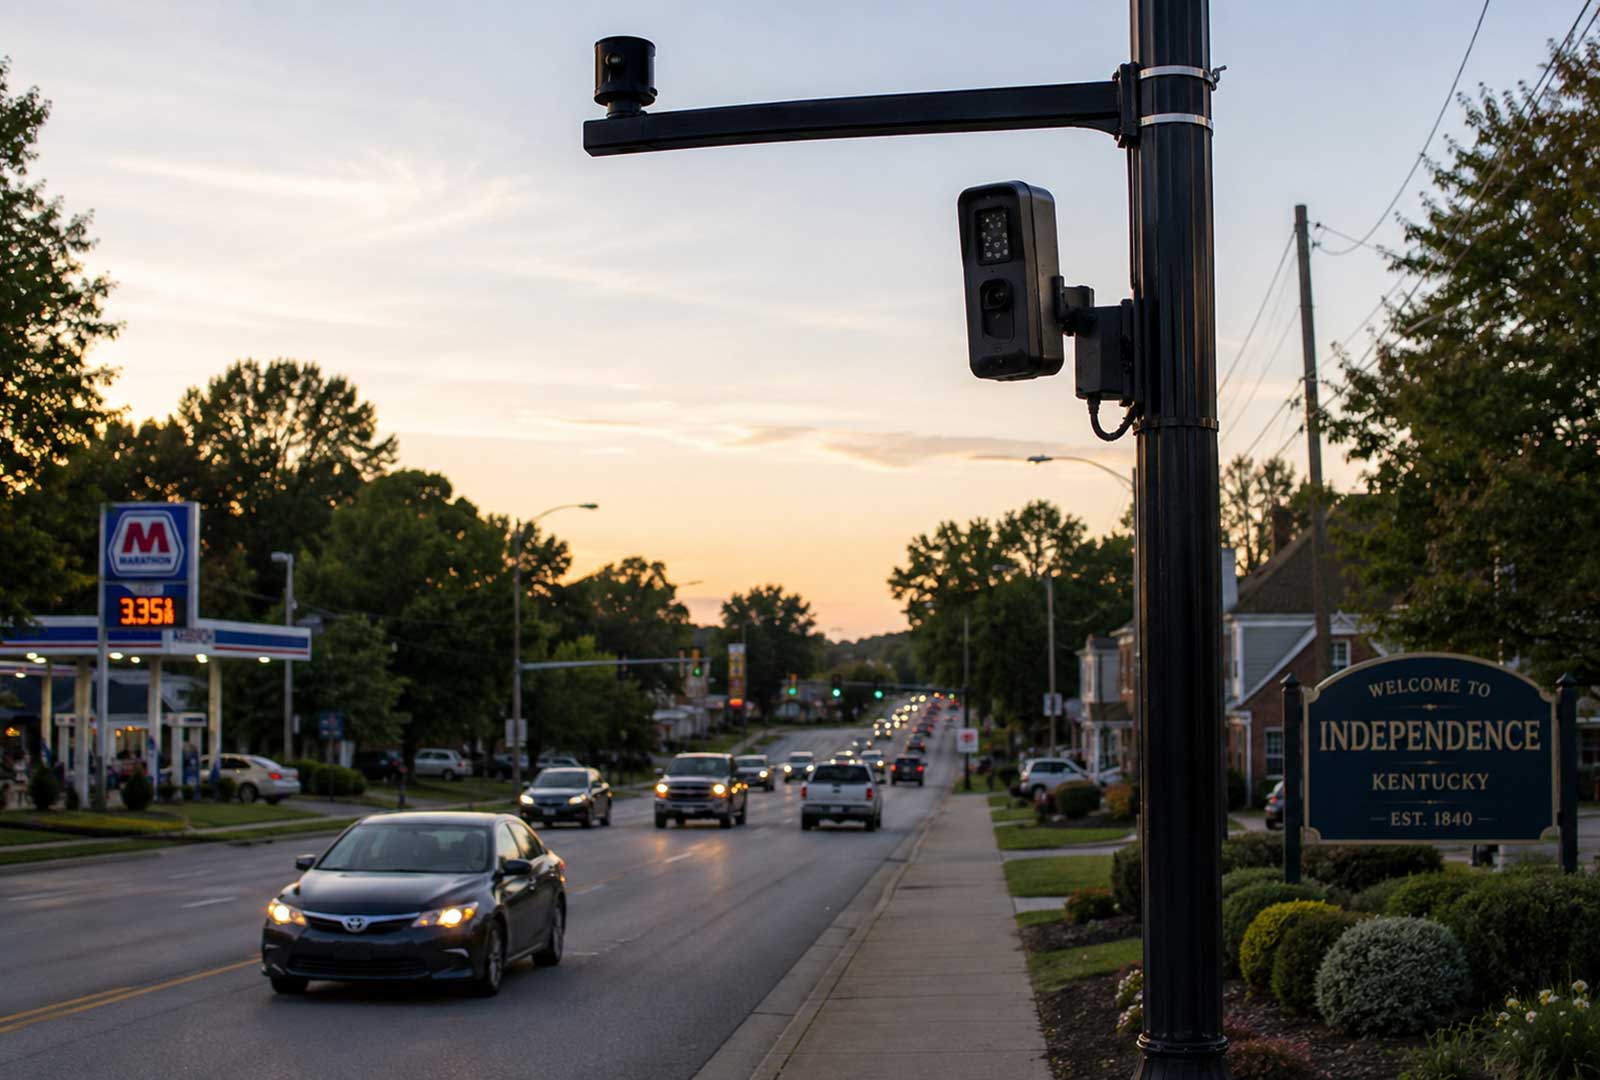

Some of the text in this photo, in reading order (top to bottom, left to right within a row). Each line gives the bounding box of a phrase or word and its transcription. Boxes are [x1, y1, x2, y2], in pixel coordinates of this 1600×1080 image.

[122, 522, 170, 553] M
[119, 556, 171, 565] MARATHON
[1368, 677, 1491, 698] WELCOME TO
[1319, 720, 1541, 751] INDEPENDENCE
[1372, 773, 1489, 791] KENTUCKY
[1390, 811, 1473, 826] EST. 1840
